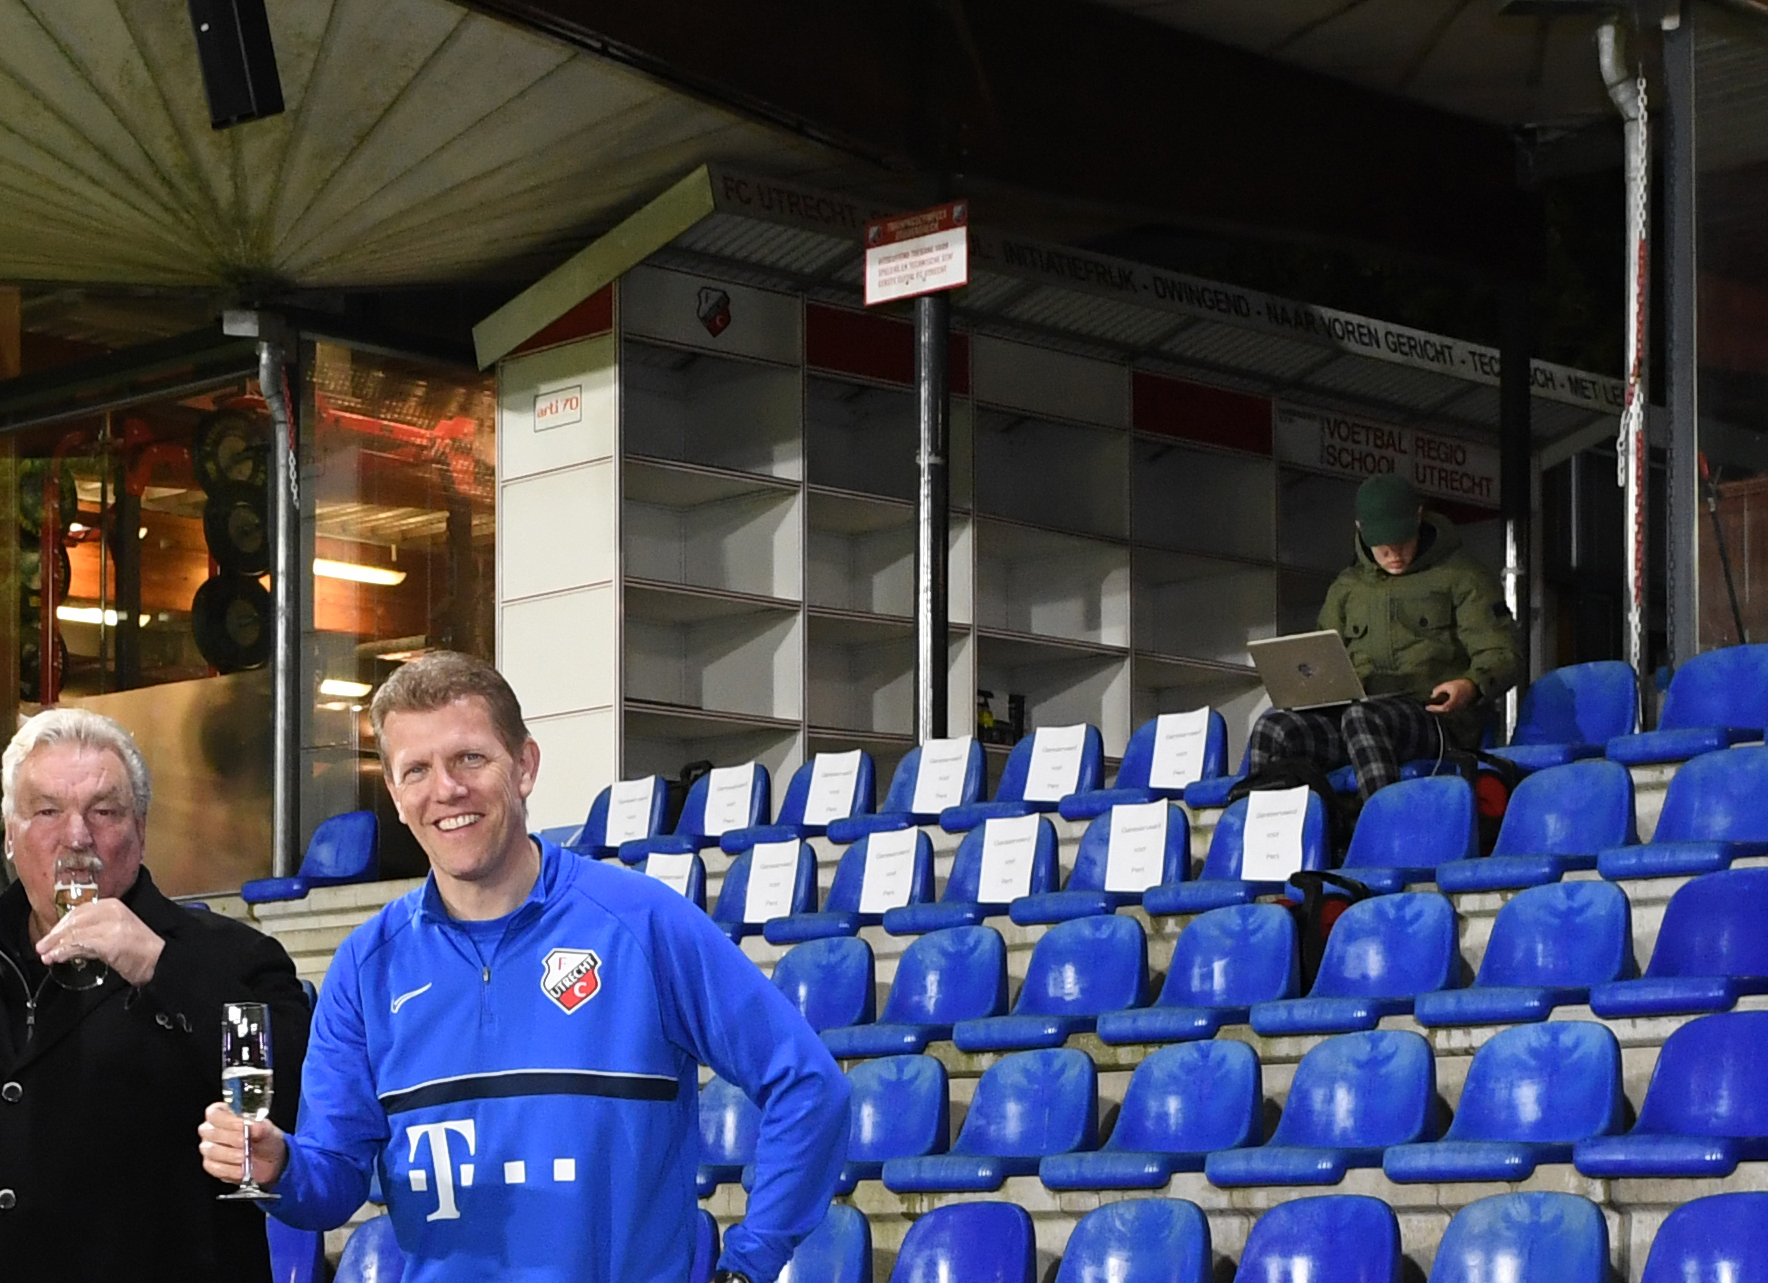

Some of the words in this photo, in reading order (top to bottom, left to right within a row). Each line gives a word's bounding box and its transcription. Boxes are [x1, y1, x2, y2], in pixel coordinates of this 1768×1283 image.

[1152, 275, 1250, 318] DWINGEND
[1266, 303, 1317, 334] NAAR
[1320, 316, 1381, 350] VOREN
[1384, 330, 1454, 366] GERICHT
[1326, 417, 1407, 454] VOETBAL
[1414, 436, 1466, 466] REGIO
[1414, 463, 1492, 497] UTRECHT
[549, 956, 595, 999] UTRECHT
[573, 981, 588, 998] C
